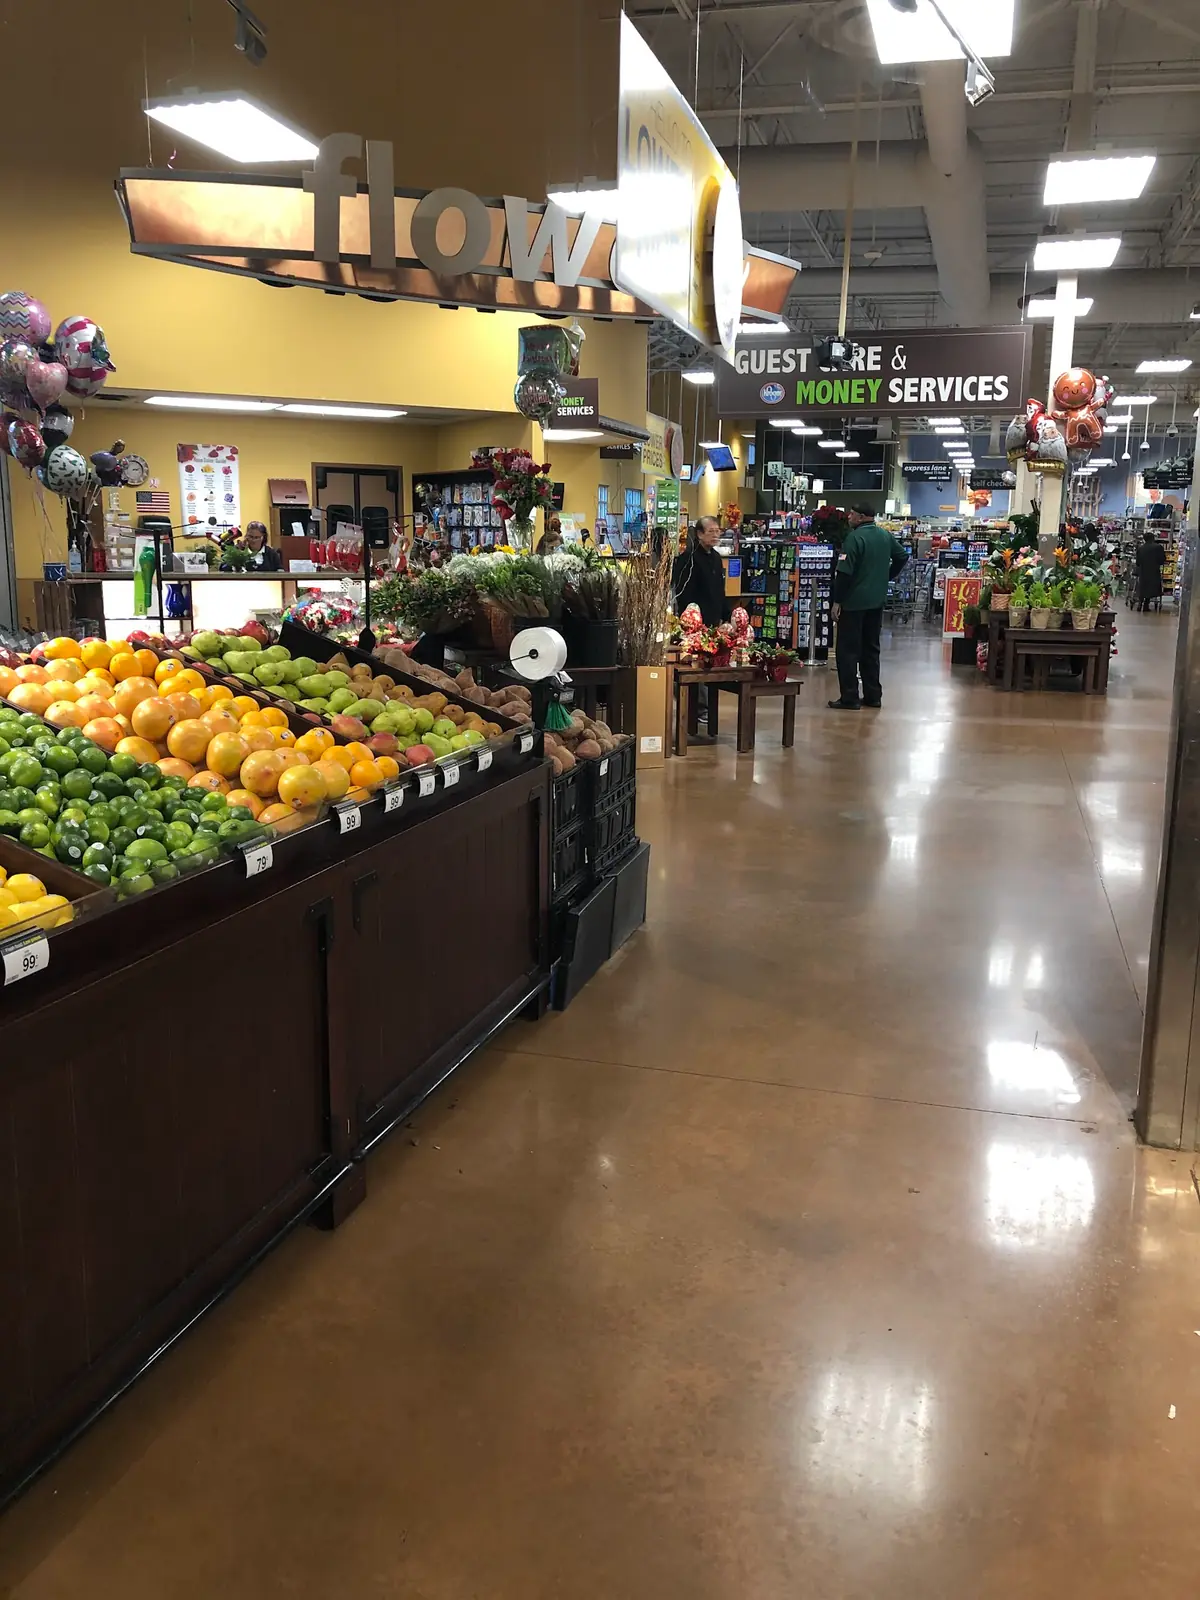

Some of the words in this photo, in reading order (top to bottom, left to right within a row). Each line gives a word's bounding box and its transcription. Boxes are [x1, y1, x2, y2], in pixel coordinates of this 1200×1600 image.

[302, 132, 617, 288] flow
[735, 348, 811, 375] GUEST
[820, 345, 882, 372] RE
[891, 345, 906, 371] &
[796, 379, 882, 405] MONEY
[888, 375, 1009, 403] SERVICES
[557, 406, 594, 416] SERVICES
[904, 465, 930, 473] express
[931, 464, 947, 472] lane
